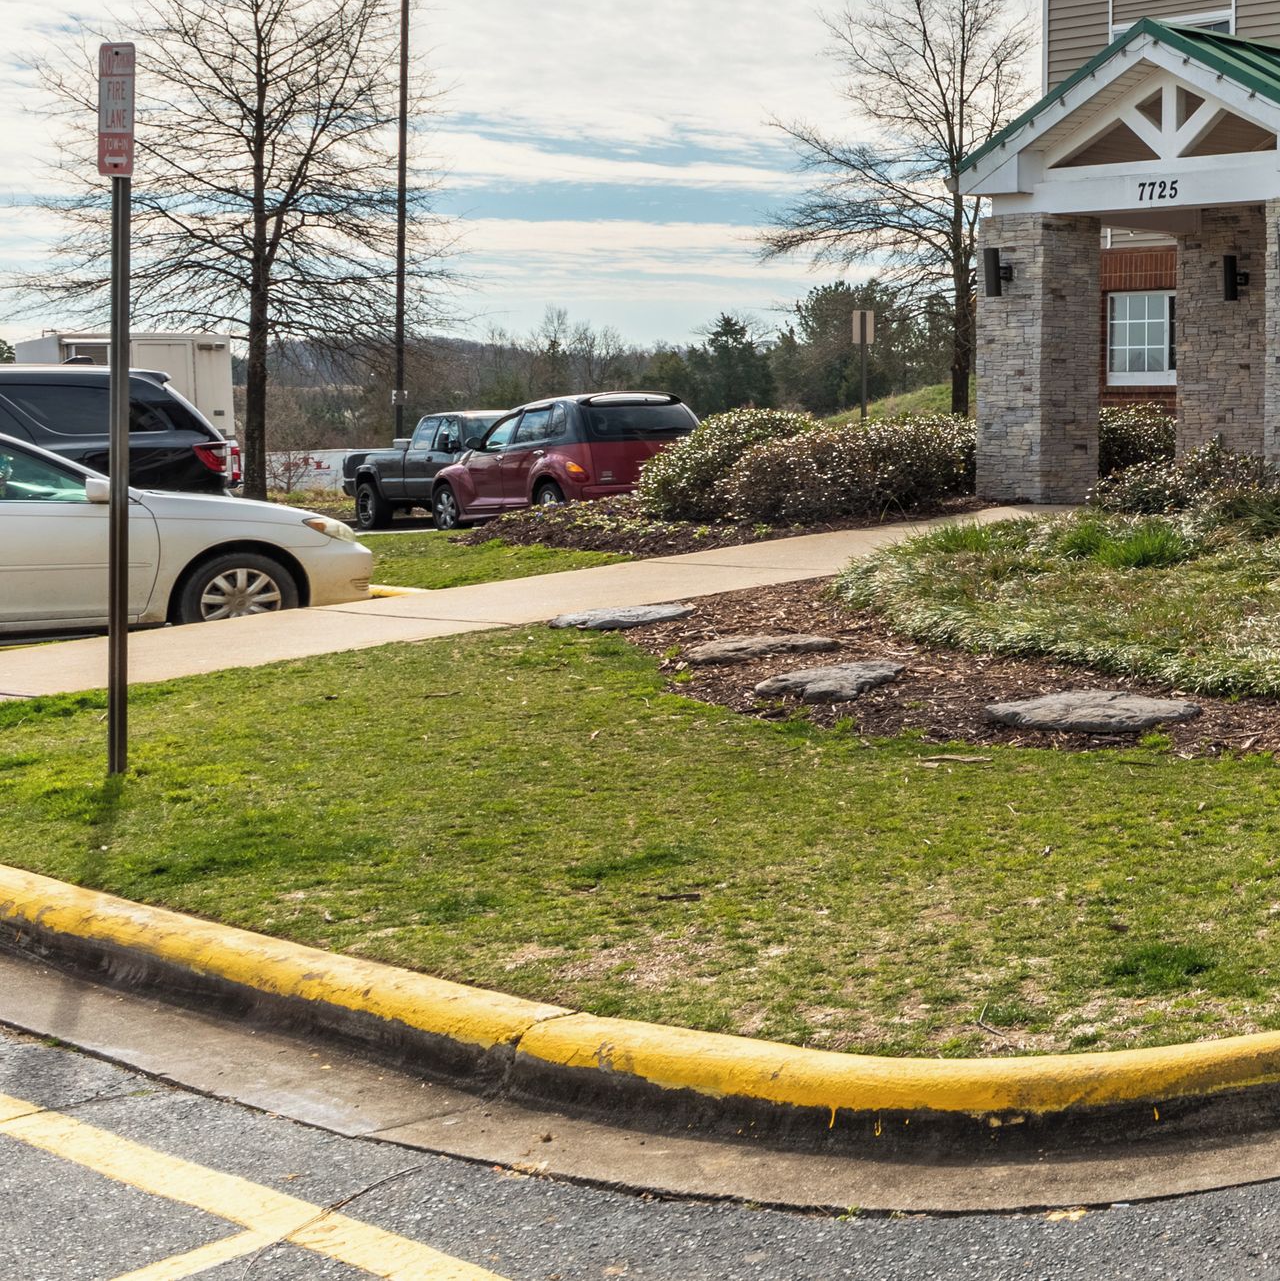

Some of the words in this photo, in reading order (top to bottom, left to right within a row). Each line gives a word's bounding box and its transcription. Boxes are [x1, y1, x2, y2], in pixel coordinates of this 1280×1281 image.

[100, 50, 112, 75] NO
[107, 81, 126, 101] FIRE
[106, 109, 127, 129] LANE
[103, 138, 129, 150] TOW-IN
[1137, 179, 1179, 201] 7725
